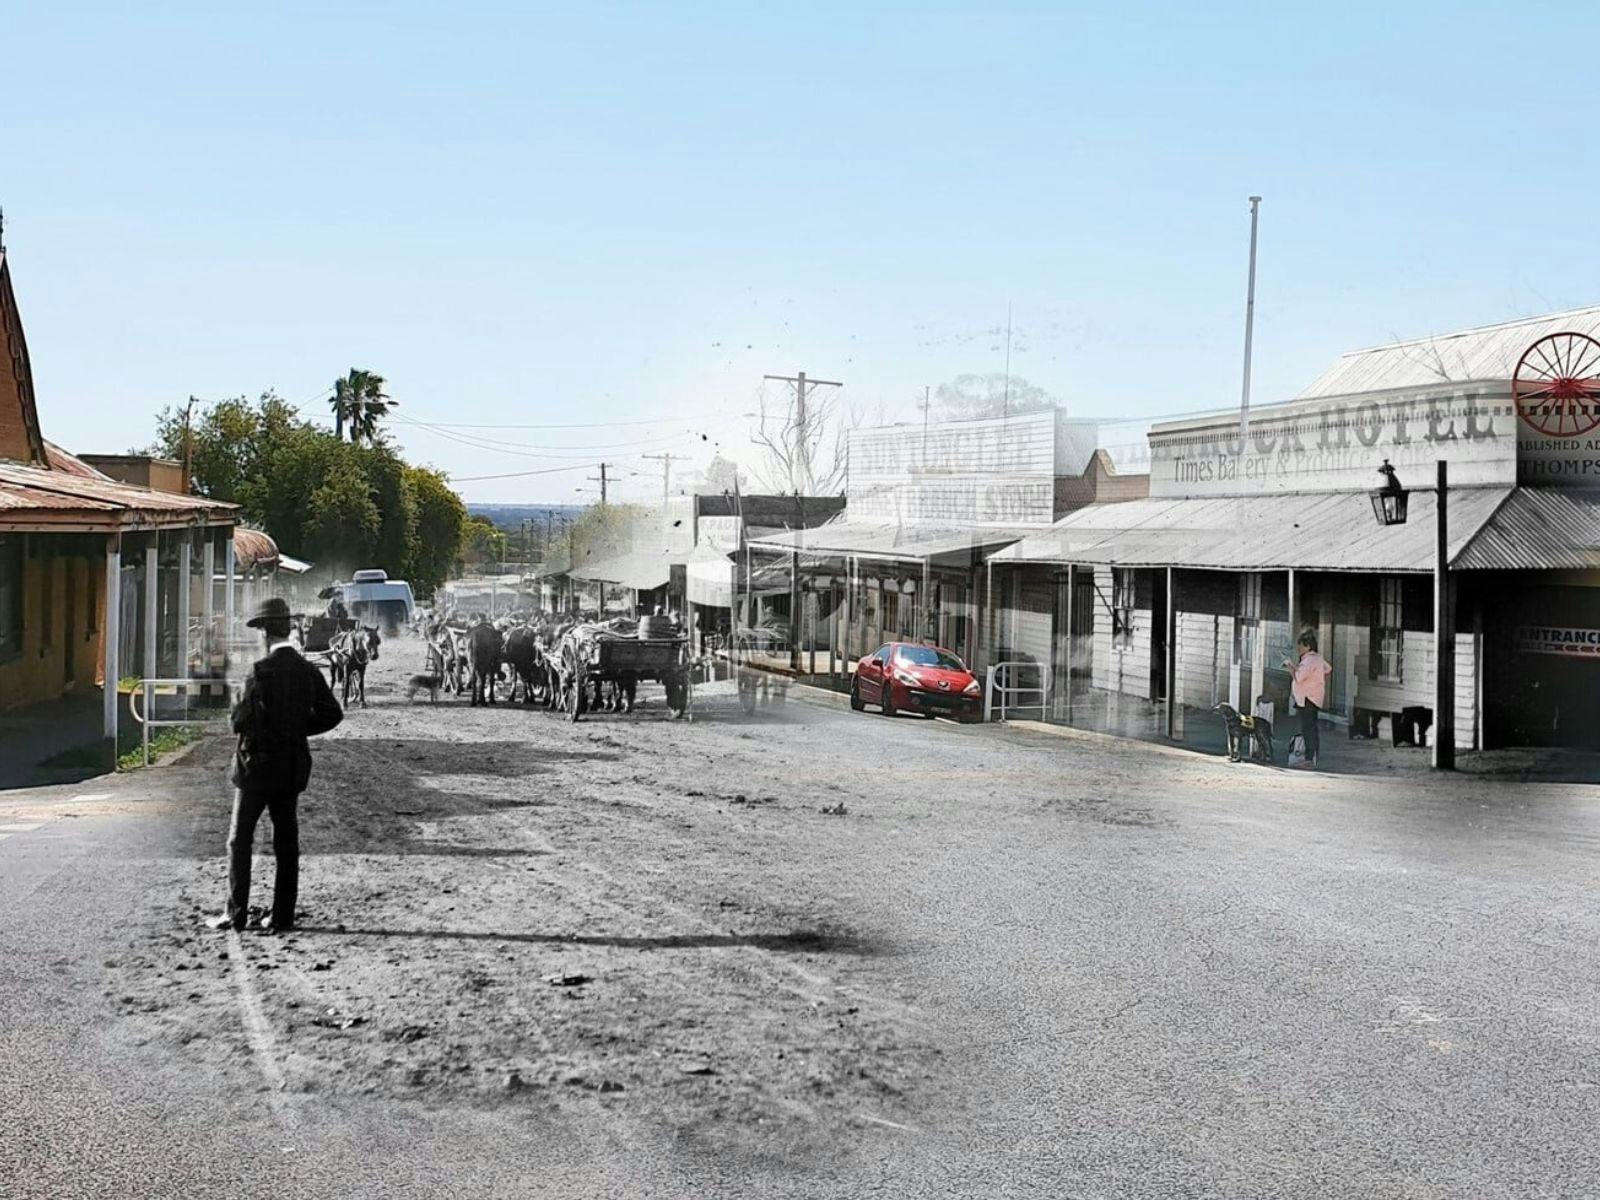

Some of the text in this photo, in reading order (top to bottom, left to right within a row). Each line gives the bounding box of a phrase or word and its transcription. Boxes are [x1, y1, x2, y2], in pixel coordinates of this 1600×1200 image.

[1316, 392, 1497, 447] HOTEL
[1173, 454, 1214, 483] Times
[1520, 628, 1600, 644] ENTRANC
